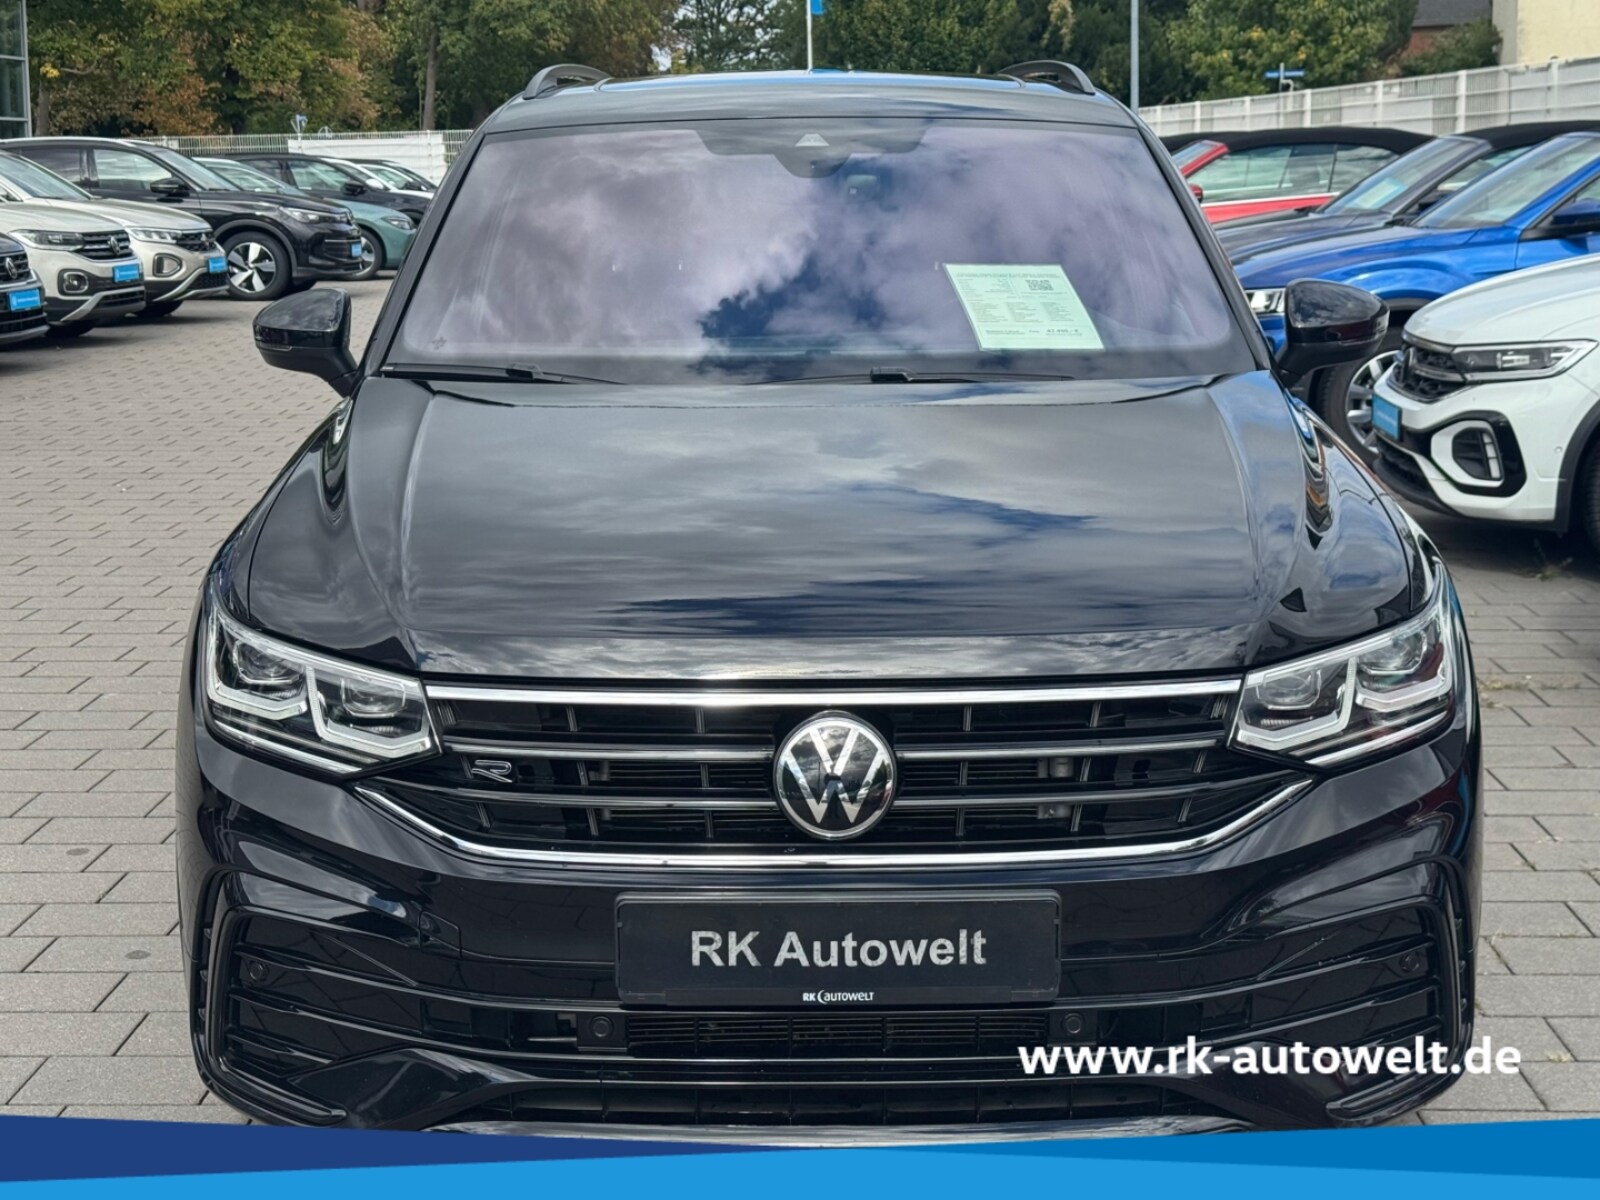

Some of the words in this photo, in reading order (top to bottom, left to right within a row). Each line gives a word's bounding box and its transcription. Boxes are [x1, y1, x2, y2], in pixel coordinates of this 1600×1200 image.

[471, 759, 513, 783] R
[777, 715, 893, 839] VW
[691, 930, 761, 967] RK
[773, 928, 987, 968] Autowelt
[802, 992, 817, 1002] RK
